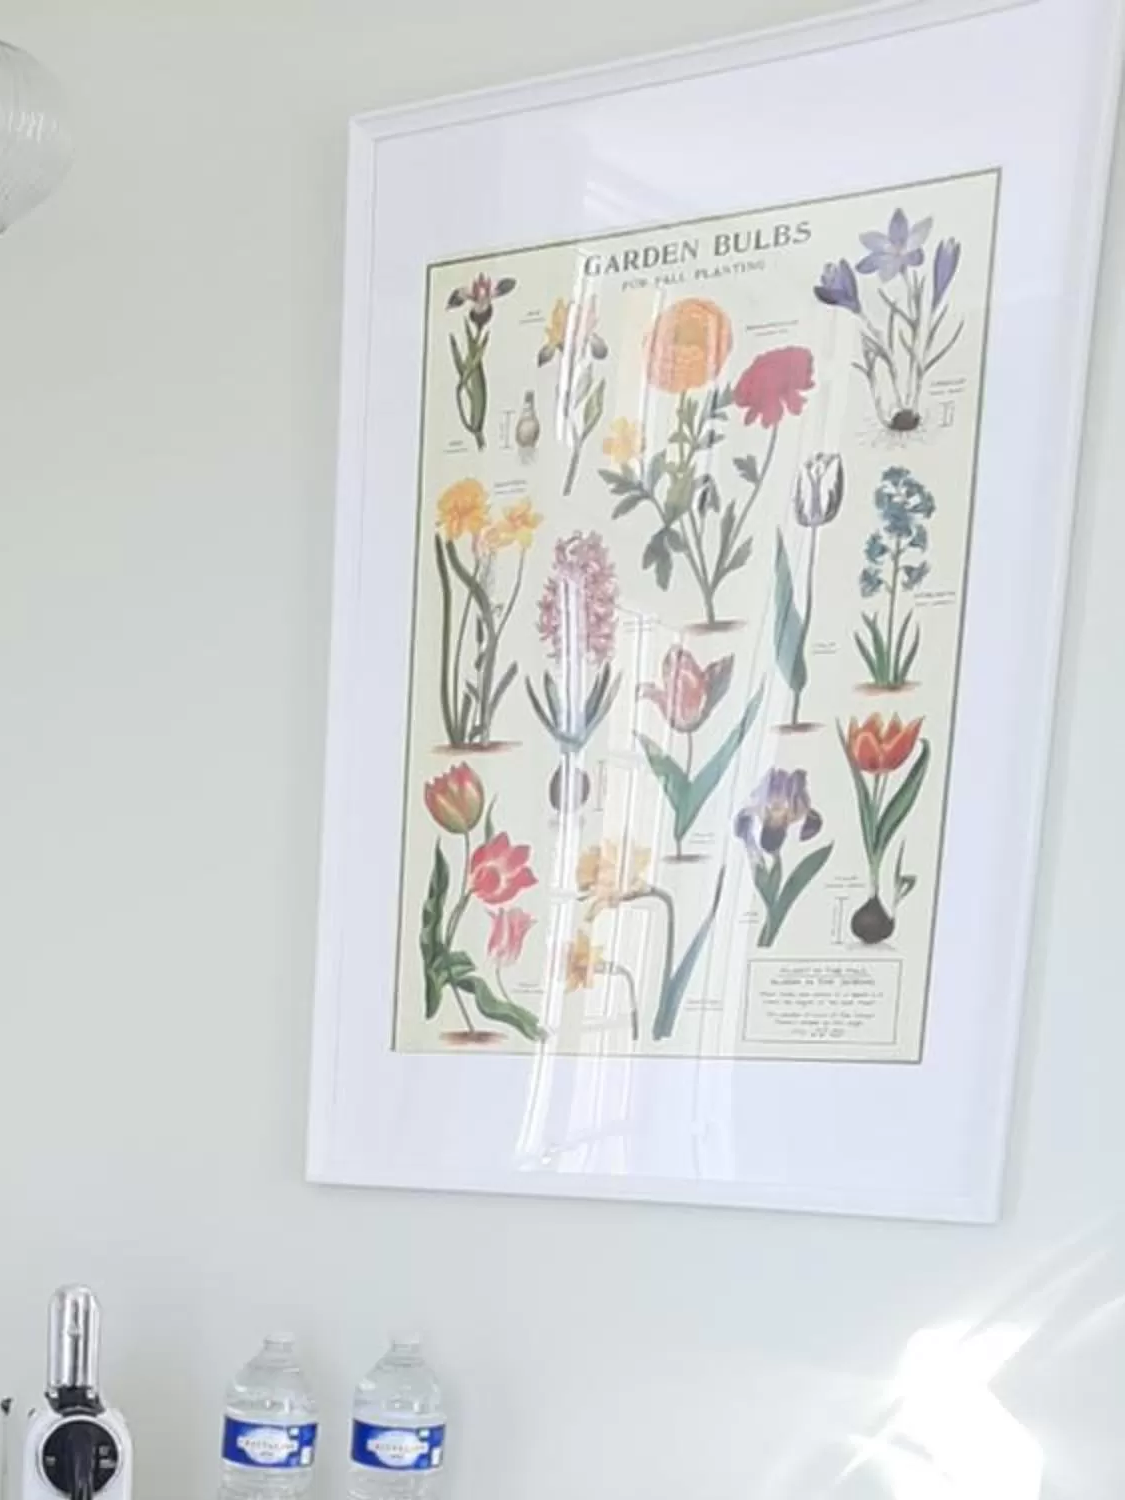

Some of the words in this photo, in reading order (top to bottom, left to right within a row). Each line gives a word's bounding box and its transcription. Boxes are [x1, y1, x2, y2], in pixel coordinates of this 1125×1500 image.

[584, 239, 699, 277] GARDEN
[714, 221, 812, 257] BULBS
[695, 260, 765, 281] PLANTING
